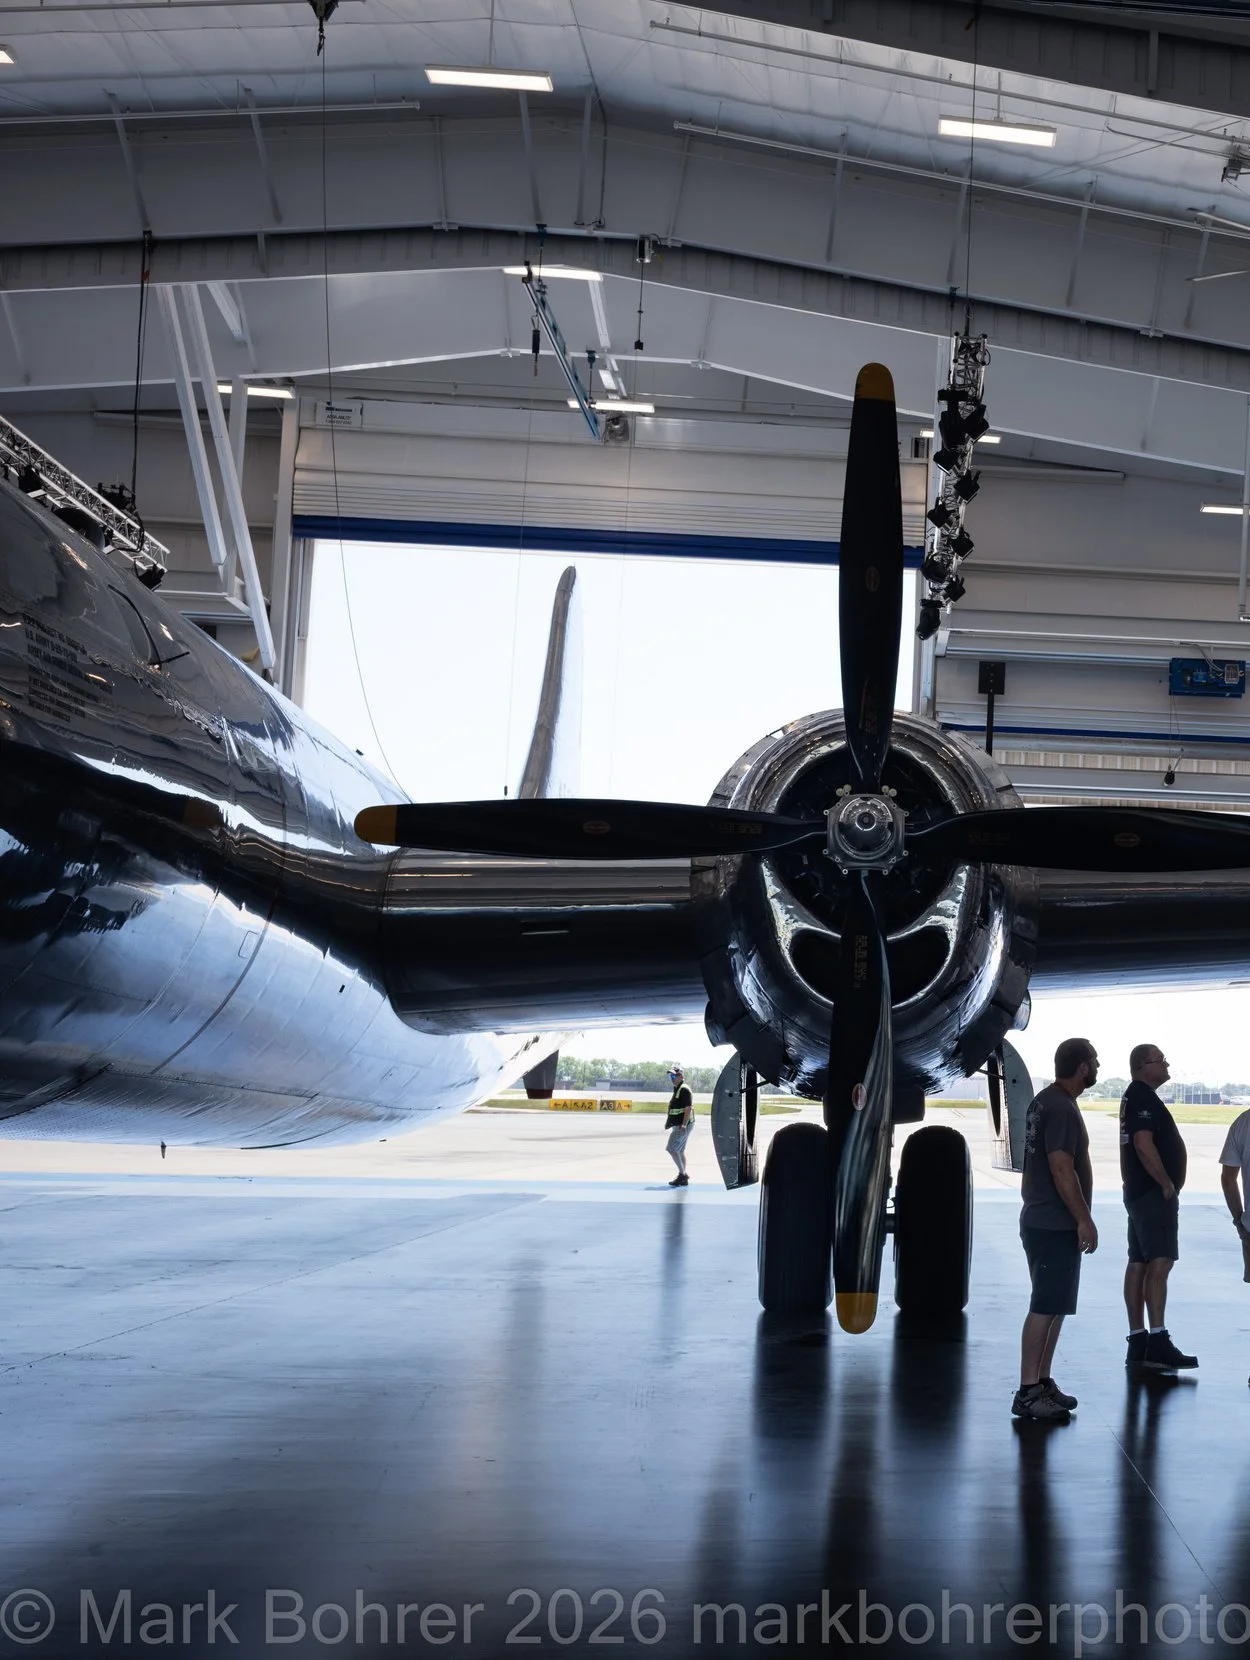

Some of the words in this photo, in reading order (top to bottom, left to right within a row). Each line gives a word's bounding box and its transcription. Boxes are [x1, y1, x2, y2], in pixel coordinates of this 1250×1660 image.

[581, 1102, 593, 1110] A2
[602, 1102, 614, 1110] A3
[616, 1102, 622, 1110] A
